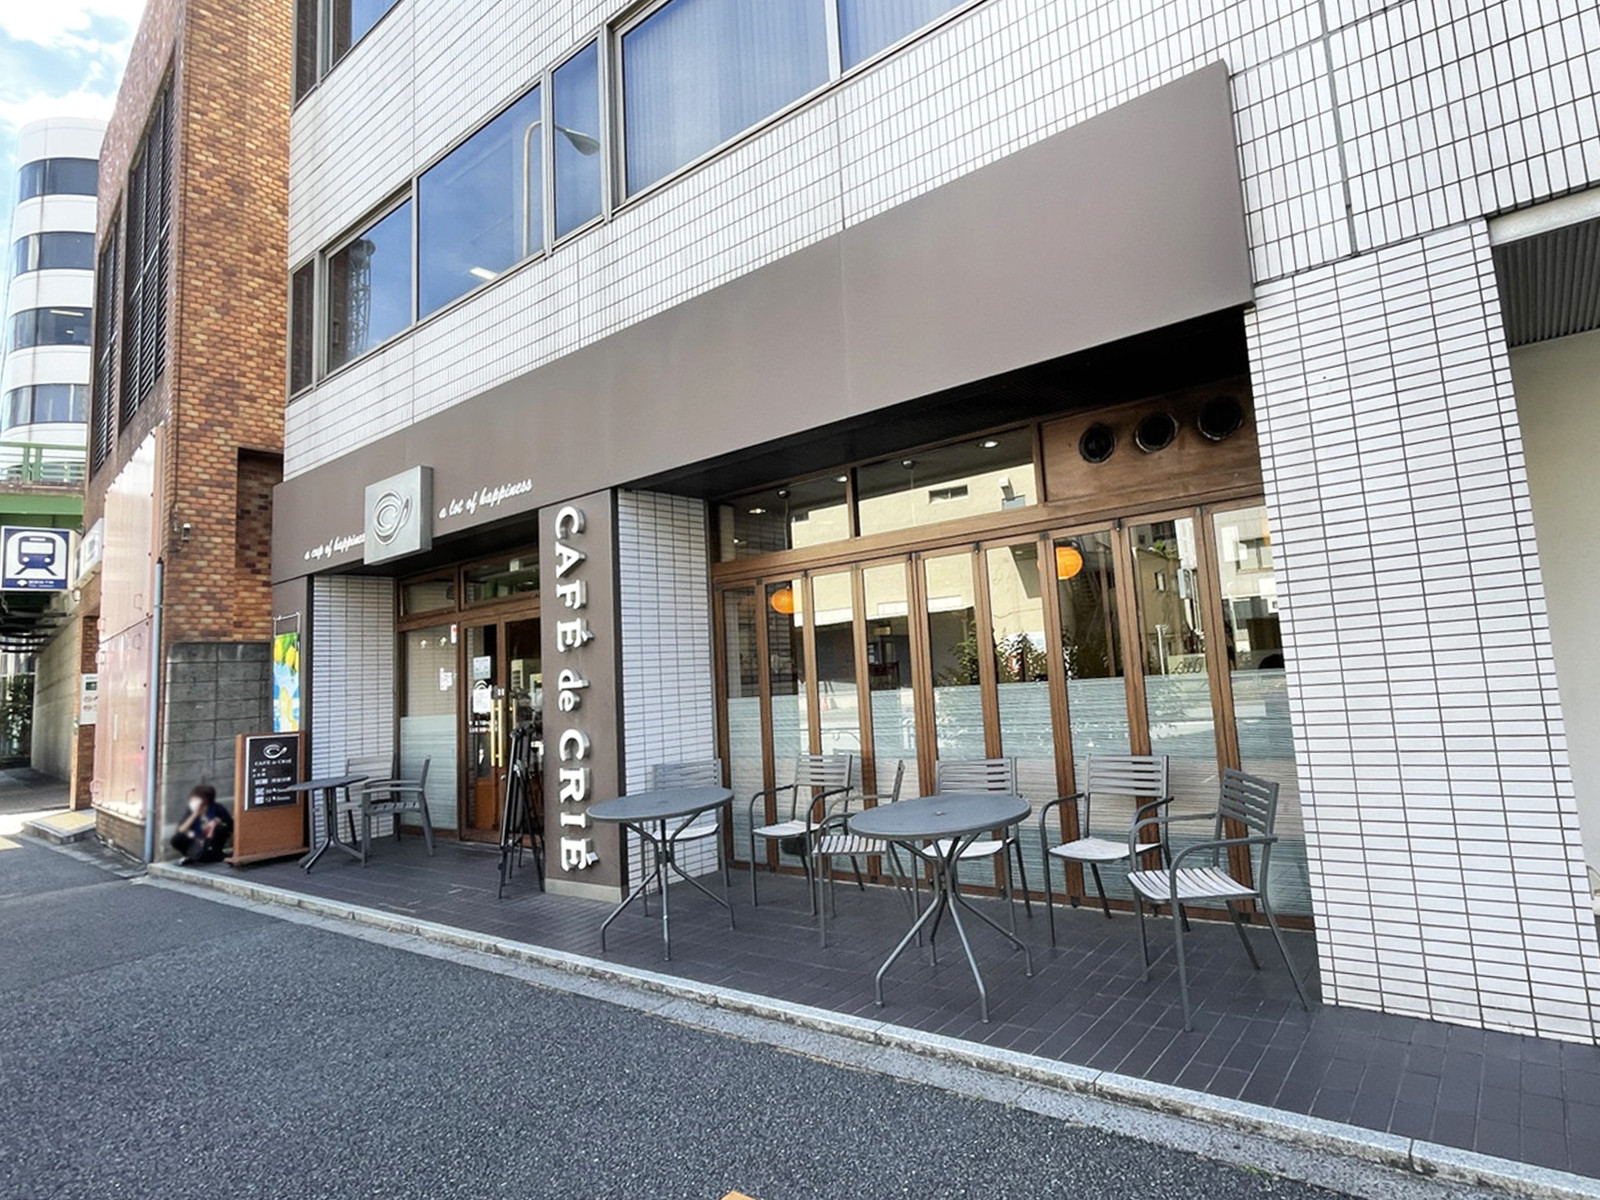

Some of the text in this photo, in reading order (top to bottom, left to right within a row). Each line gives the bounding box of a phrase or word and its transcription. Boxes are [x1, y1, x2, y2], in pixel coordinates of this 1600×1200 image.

[439, 478, 533, 518] a lot of happiness
[304, 550, 310, 560] a
[311, 544, 324, 560] cup
[325, 538, 333, 558] of
[555, 505, 600, 872] CAFÉ de CRIÉ
